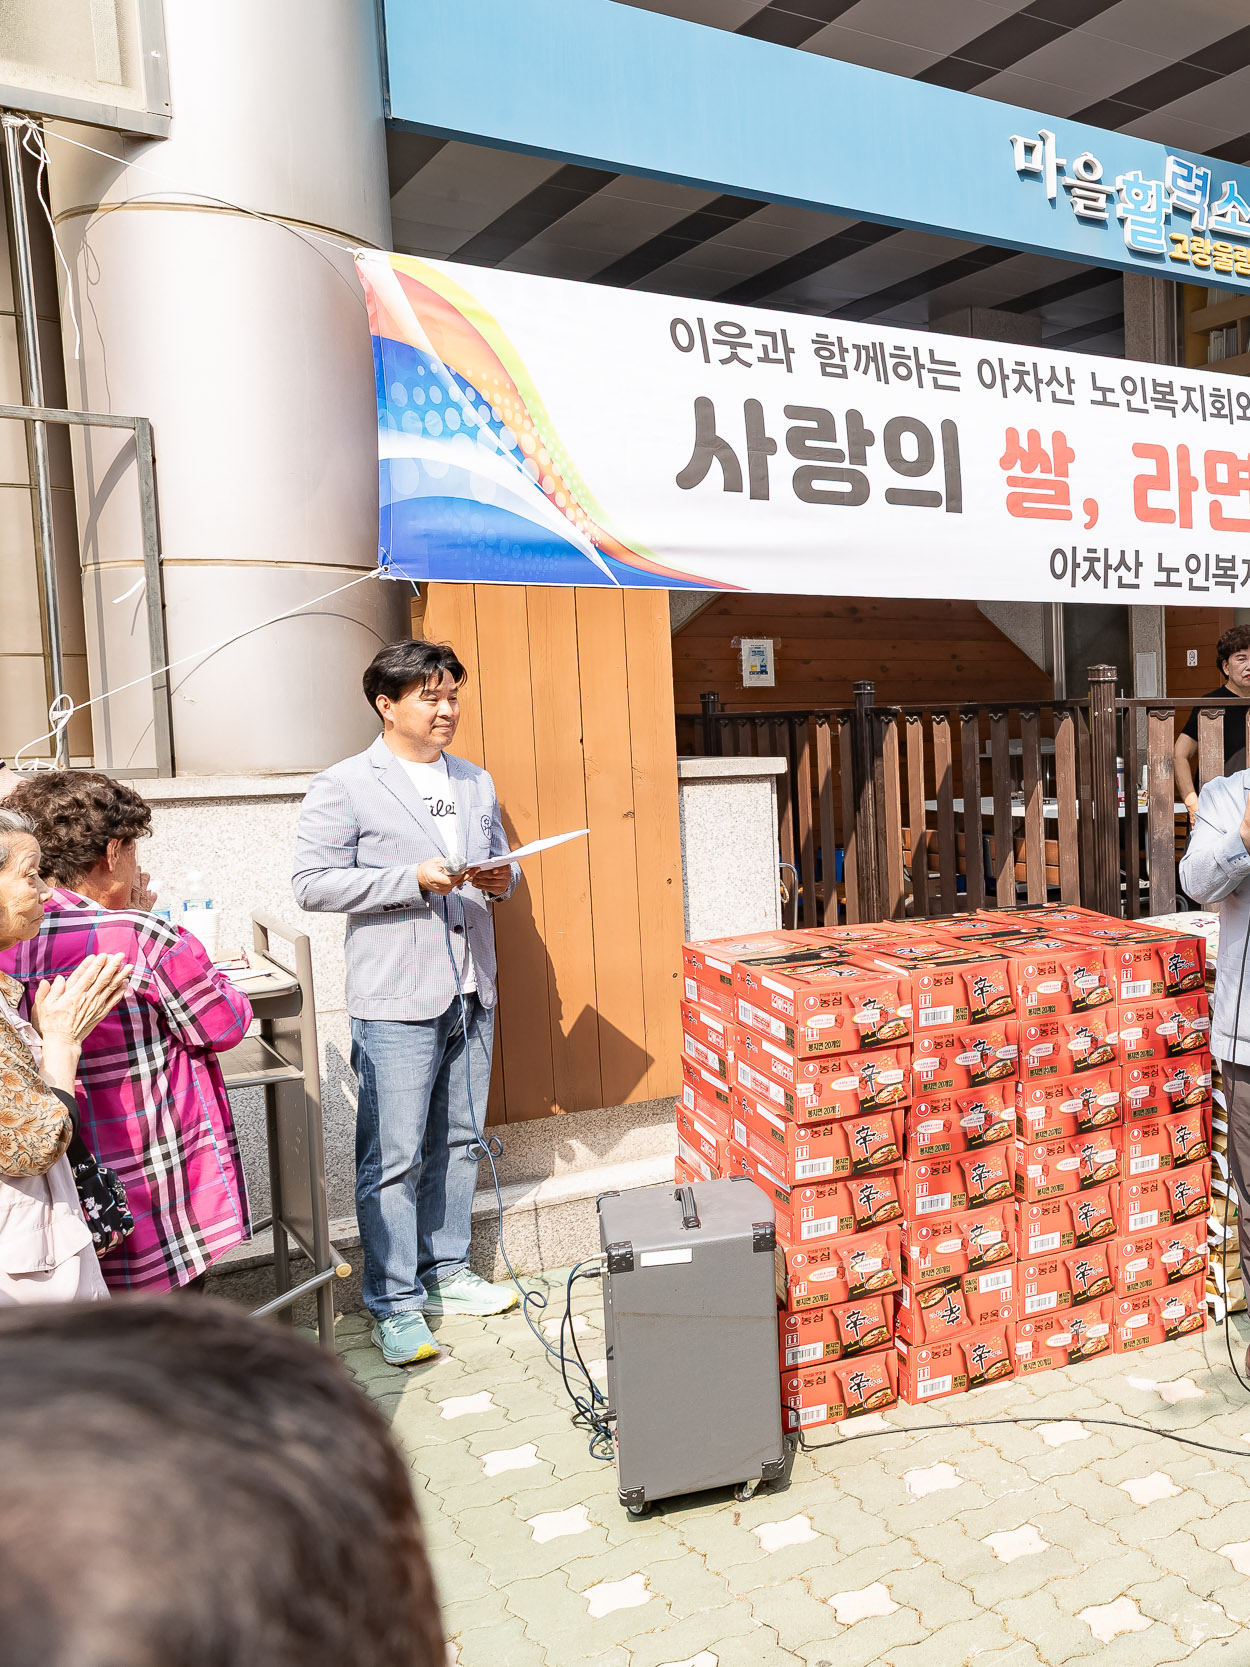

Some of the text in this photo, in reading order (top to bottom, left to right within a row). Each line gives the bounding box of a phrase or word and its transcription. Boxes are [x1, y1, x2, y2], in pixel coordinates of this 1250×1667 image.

[670, 318, 795, 373] 이웃과
[812, 333, 961, 392] 함께하는
[978, 358, 1075, 405] 아차산
[676, 396, 962, 513] 사랑의
[999, 427, 1098, 530] 쌀,
[1050, 547, 1143, 589] 아차산
[1134, 953, 1151, 962] 농심
[1038, 966, 1056, 975] 농심
[934, 976, 953, 986] 농심
[821, 997, 841, 1007] 농심
[1137, 1011, 1153, 1021] 농심
[1040, 1027, 1058, 1036] 농심
[934, 1039, 954, 1049] 농심
[820, 1063, 840, 1073] 농심
[1142, 1069, 1158, 1078] 농심
[1046, 1089, 1063, 1099] 농심
[931, 1103, 951, 1113] 농심
[812, 1127, 832, 1137] 농심
[1142, 1127, 1159, 1137] 농심
[1047, 1145, 1065, 1156] 농심
[931, 1165, 950, 1175] 농심
[817, 1187, 837, 1198] 농심
[1142, 1184, 1157, 1194] 농심
[1042, 1205, 1060, 1215] 농심
[932, 1225, 951, 1236] 농심
[1136, 1242, 1152, 1252] 농심
[809, 1252, 830, 1263] 농심
[1039, 1265, 1057, 1275] 농심
[1133, 1299, 1149, 1310] 농심
[802, 1313, 823, 1325] 농심
[980, 1310, 998, 1321] 농심
[1035, 1321, 1053, 1332] 농심
[932, 1347, 951, 1359] 농심
[804, 1376, 825, 1387] 농심
